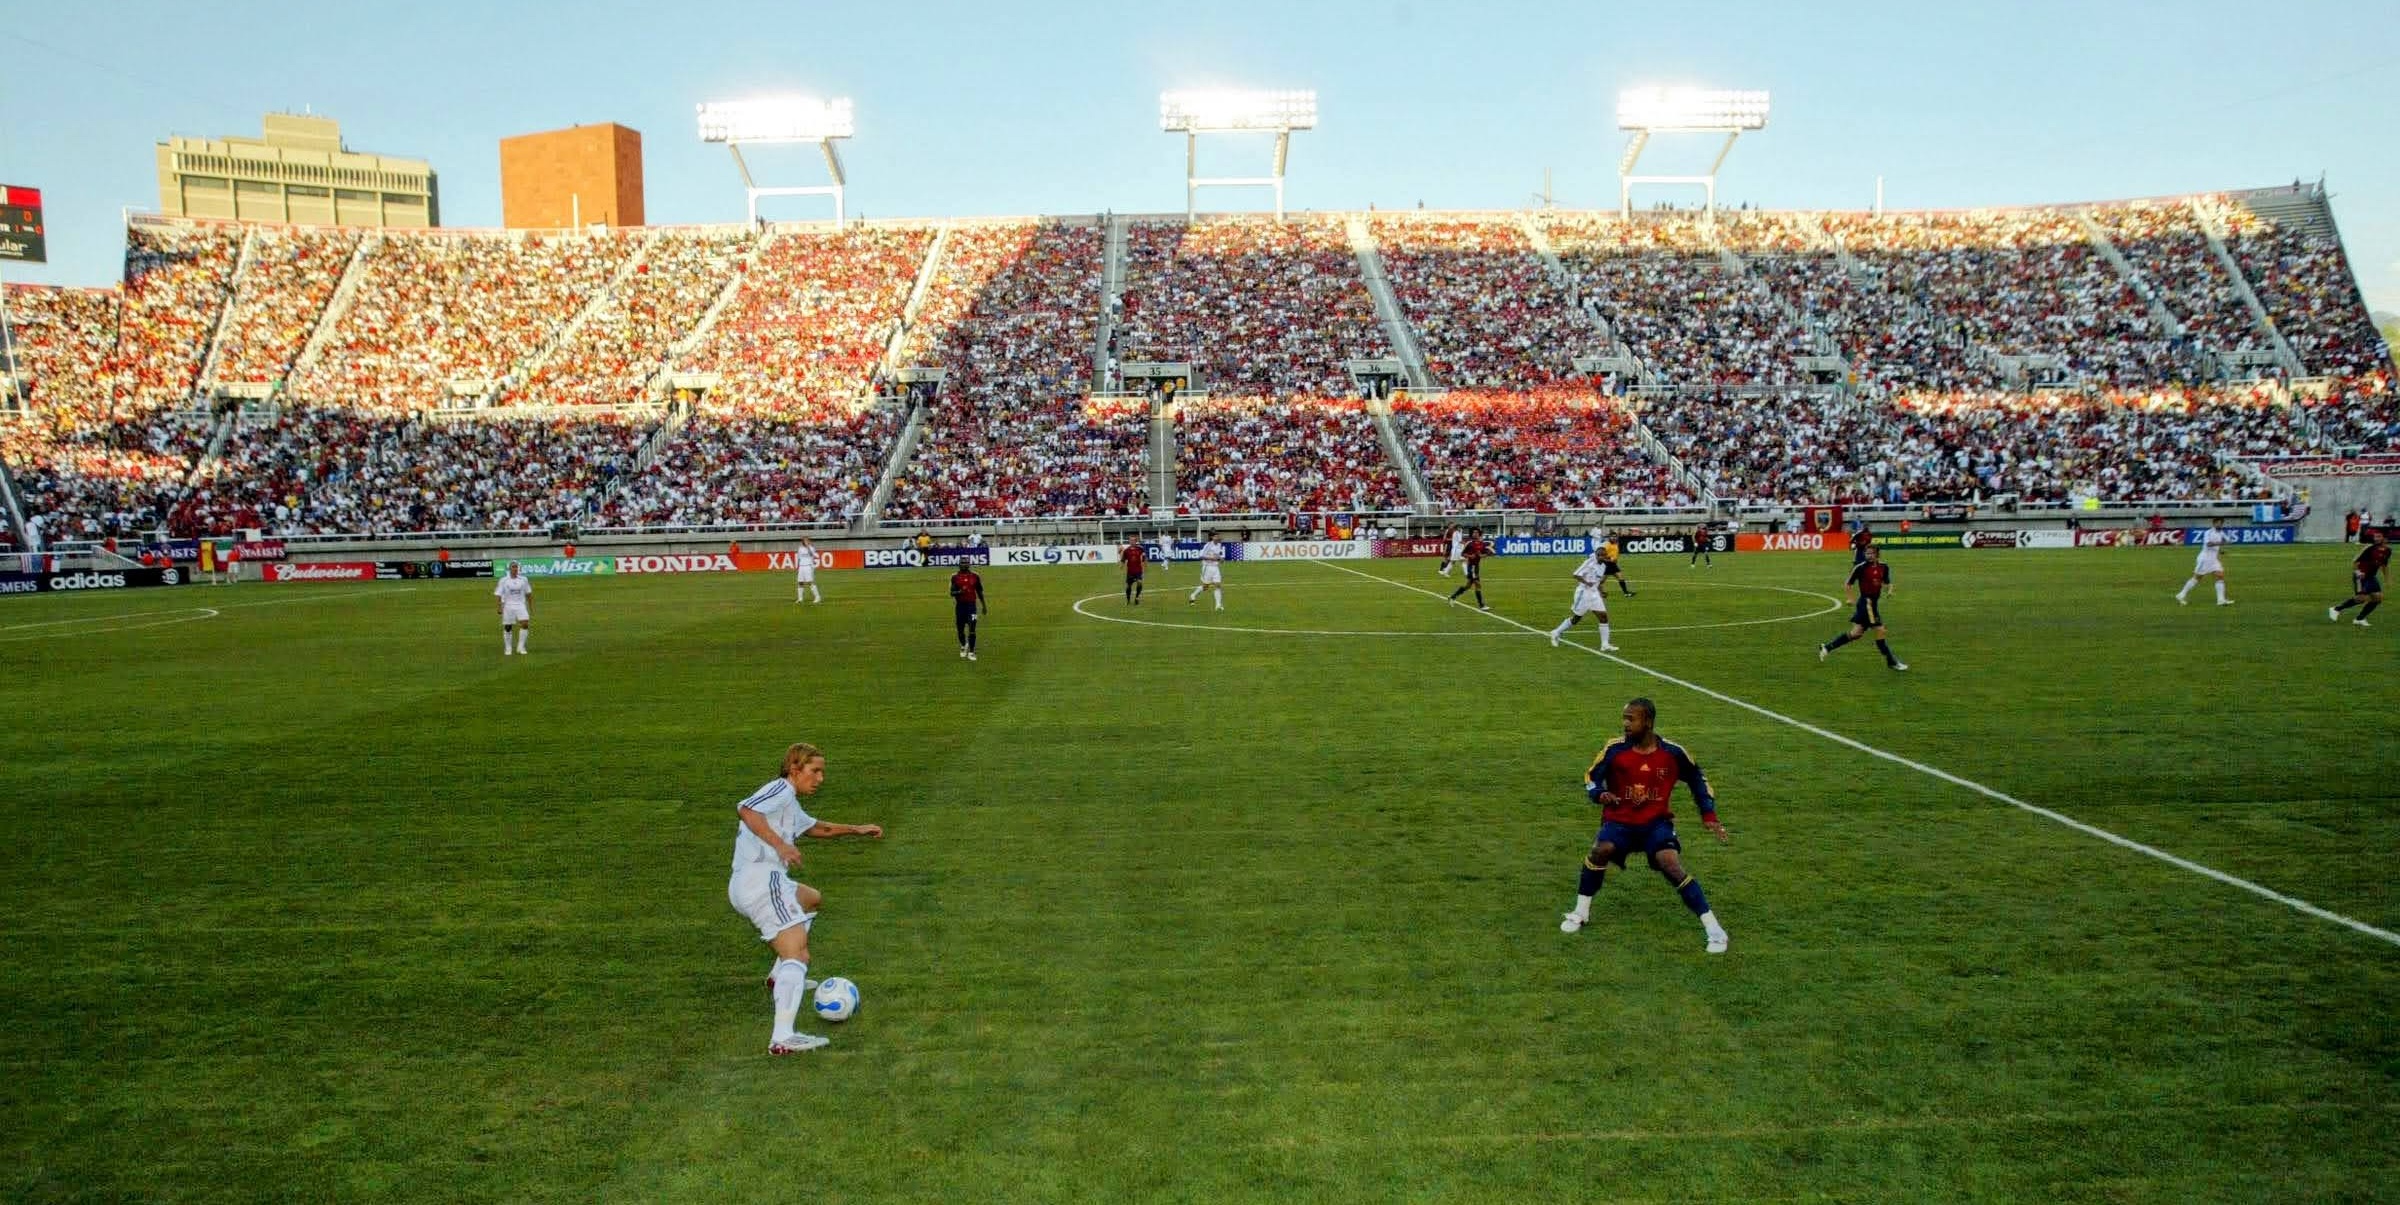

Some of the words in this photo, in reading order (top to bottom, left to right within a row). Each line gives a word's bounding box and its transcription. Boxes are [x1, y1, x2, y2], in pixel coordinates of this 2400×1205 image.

[1149, 367, 1161, 376] 35
[1368, 364, 1380, 373] 36
[1762, 533, 1824, 551] XANGO
[2078, 531, 2113, 546] KFC
[2147, 530, 2183, 545] KFC
[2242, 528, 2287, 543] BANK
[1260, 545, 1320, 558] XANGO
[1322, 543, 1356, 557] CUP
[1412, 544, 1437, 554] SALT
[1502, 540, 1529, 554] Join
[1530, 539, 1551, 554] the
[1552, 539, 1586, 553] CLUB
[1626, 537, 1684, 553] adidas
[864, 549, 922, 566] BenQ
[1008, 550, 1042, 562] KSL
[1065, 549, 1085, 560] TV
[549, 558, 593, 574] Mist
[615, 554, 738, 573] HONDA
[273, 563, 362, 580] Budweiser
[50, 572, 126, 590] adidas
